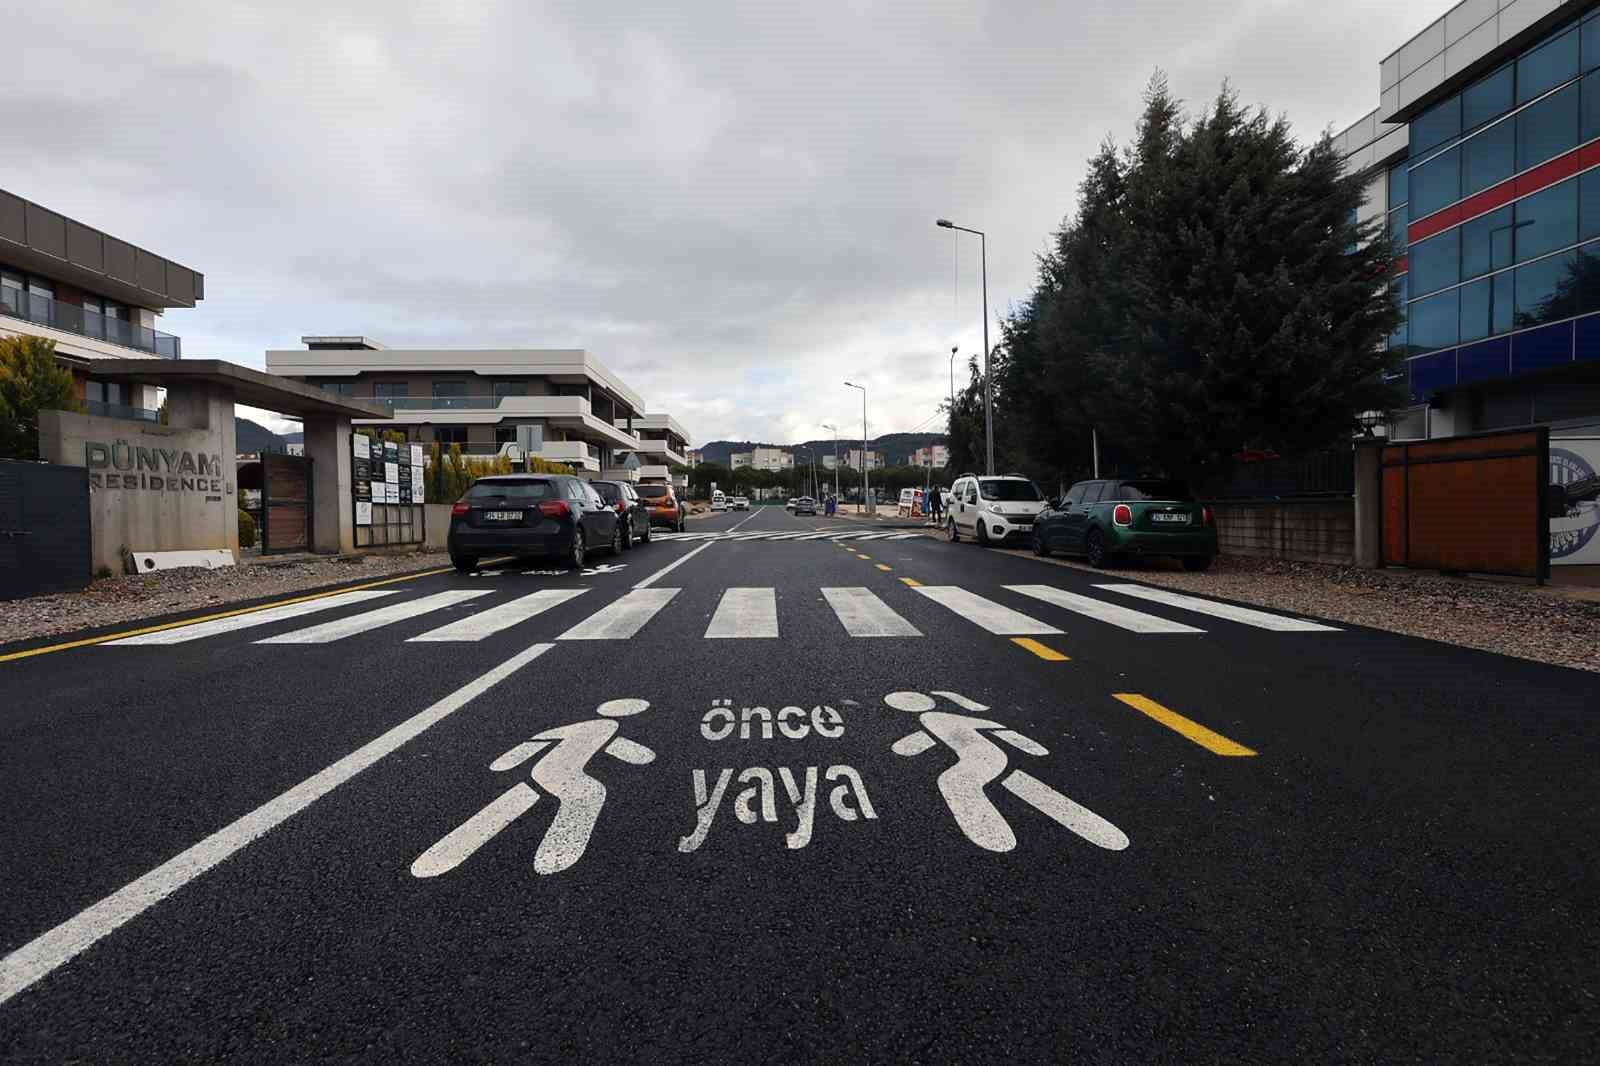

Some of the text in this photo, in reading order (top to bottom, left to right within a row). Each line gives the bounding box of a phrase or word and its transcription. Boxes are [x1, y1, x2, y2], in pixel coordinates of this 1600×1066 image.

[86, 438, 221, 477] DÜNYAM
[700, 699, 845, 741] önce
[678, 764, 879, 853] yaya
